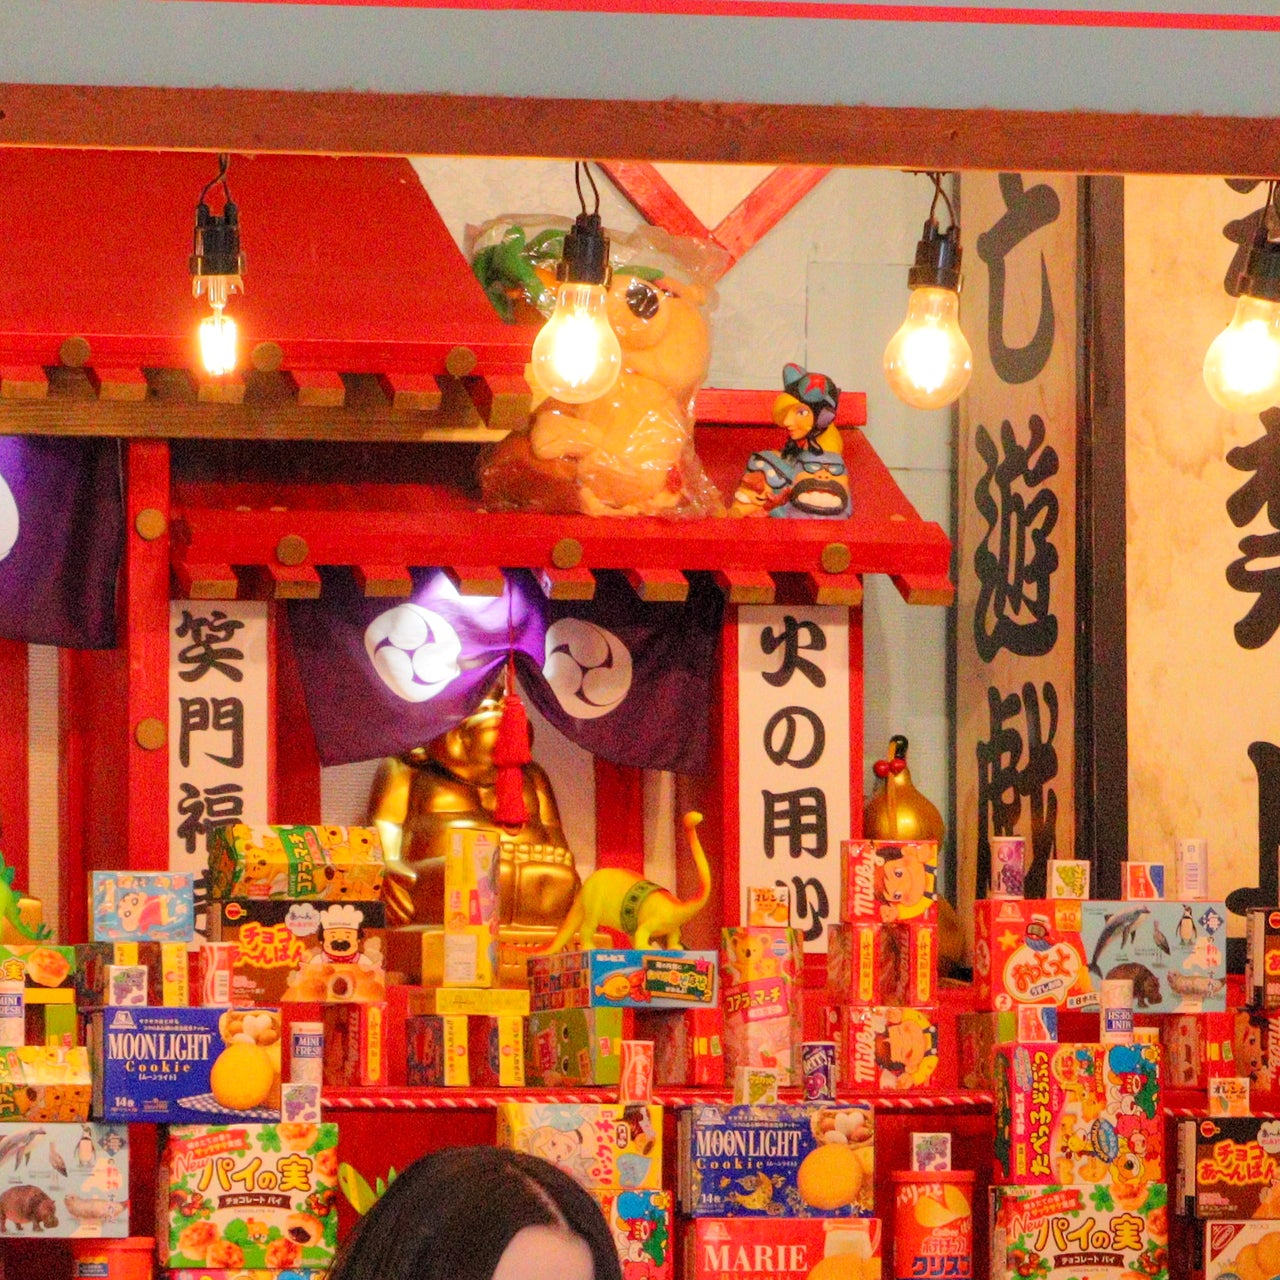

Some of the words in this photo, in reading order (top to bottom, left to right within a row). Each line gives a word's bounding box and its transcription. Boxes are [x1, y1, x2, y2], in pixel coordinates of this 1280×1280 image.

[854, 849, 885, 917] Milky
[240, 924, 293, 944] チョコ
[1015, 944, 1075, 992] おっとっと
[126, 1061, 190, 1072] Cookie
[1030, 1052, 1052, 1177] たべっ子どうぶつ
[696, 1158, 764, 1170] Cookie
[1217, 1144, 1263, 1163] チョコ
[197, 1153, 313, 1192] パイの実
[1034, 1213, 1144, 1251] パイの実
[704, 1245, 807, 1272] MARIE
